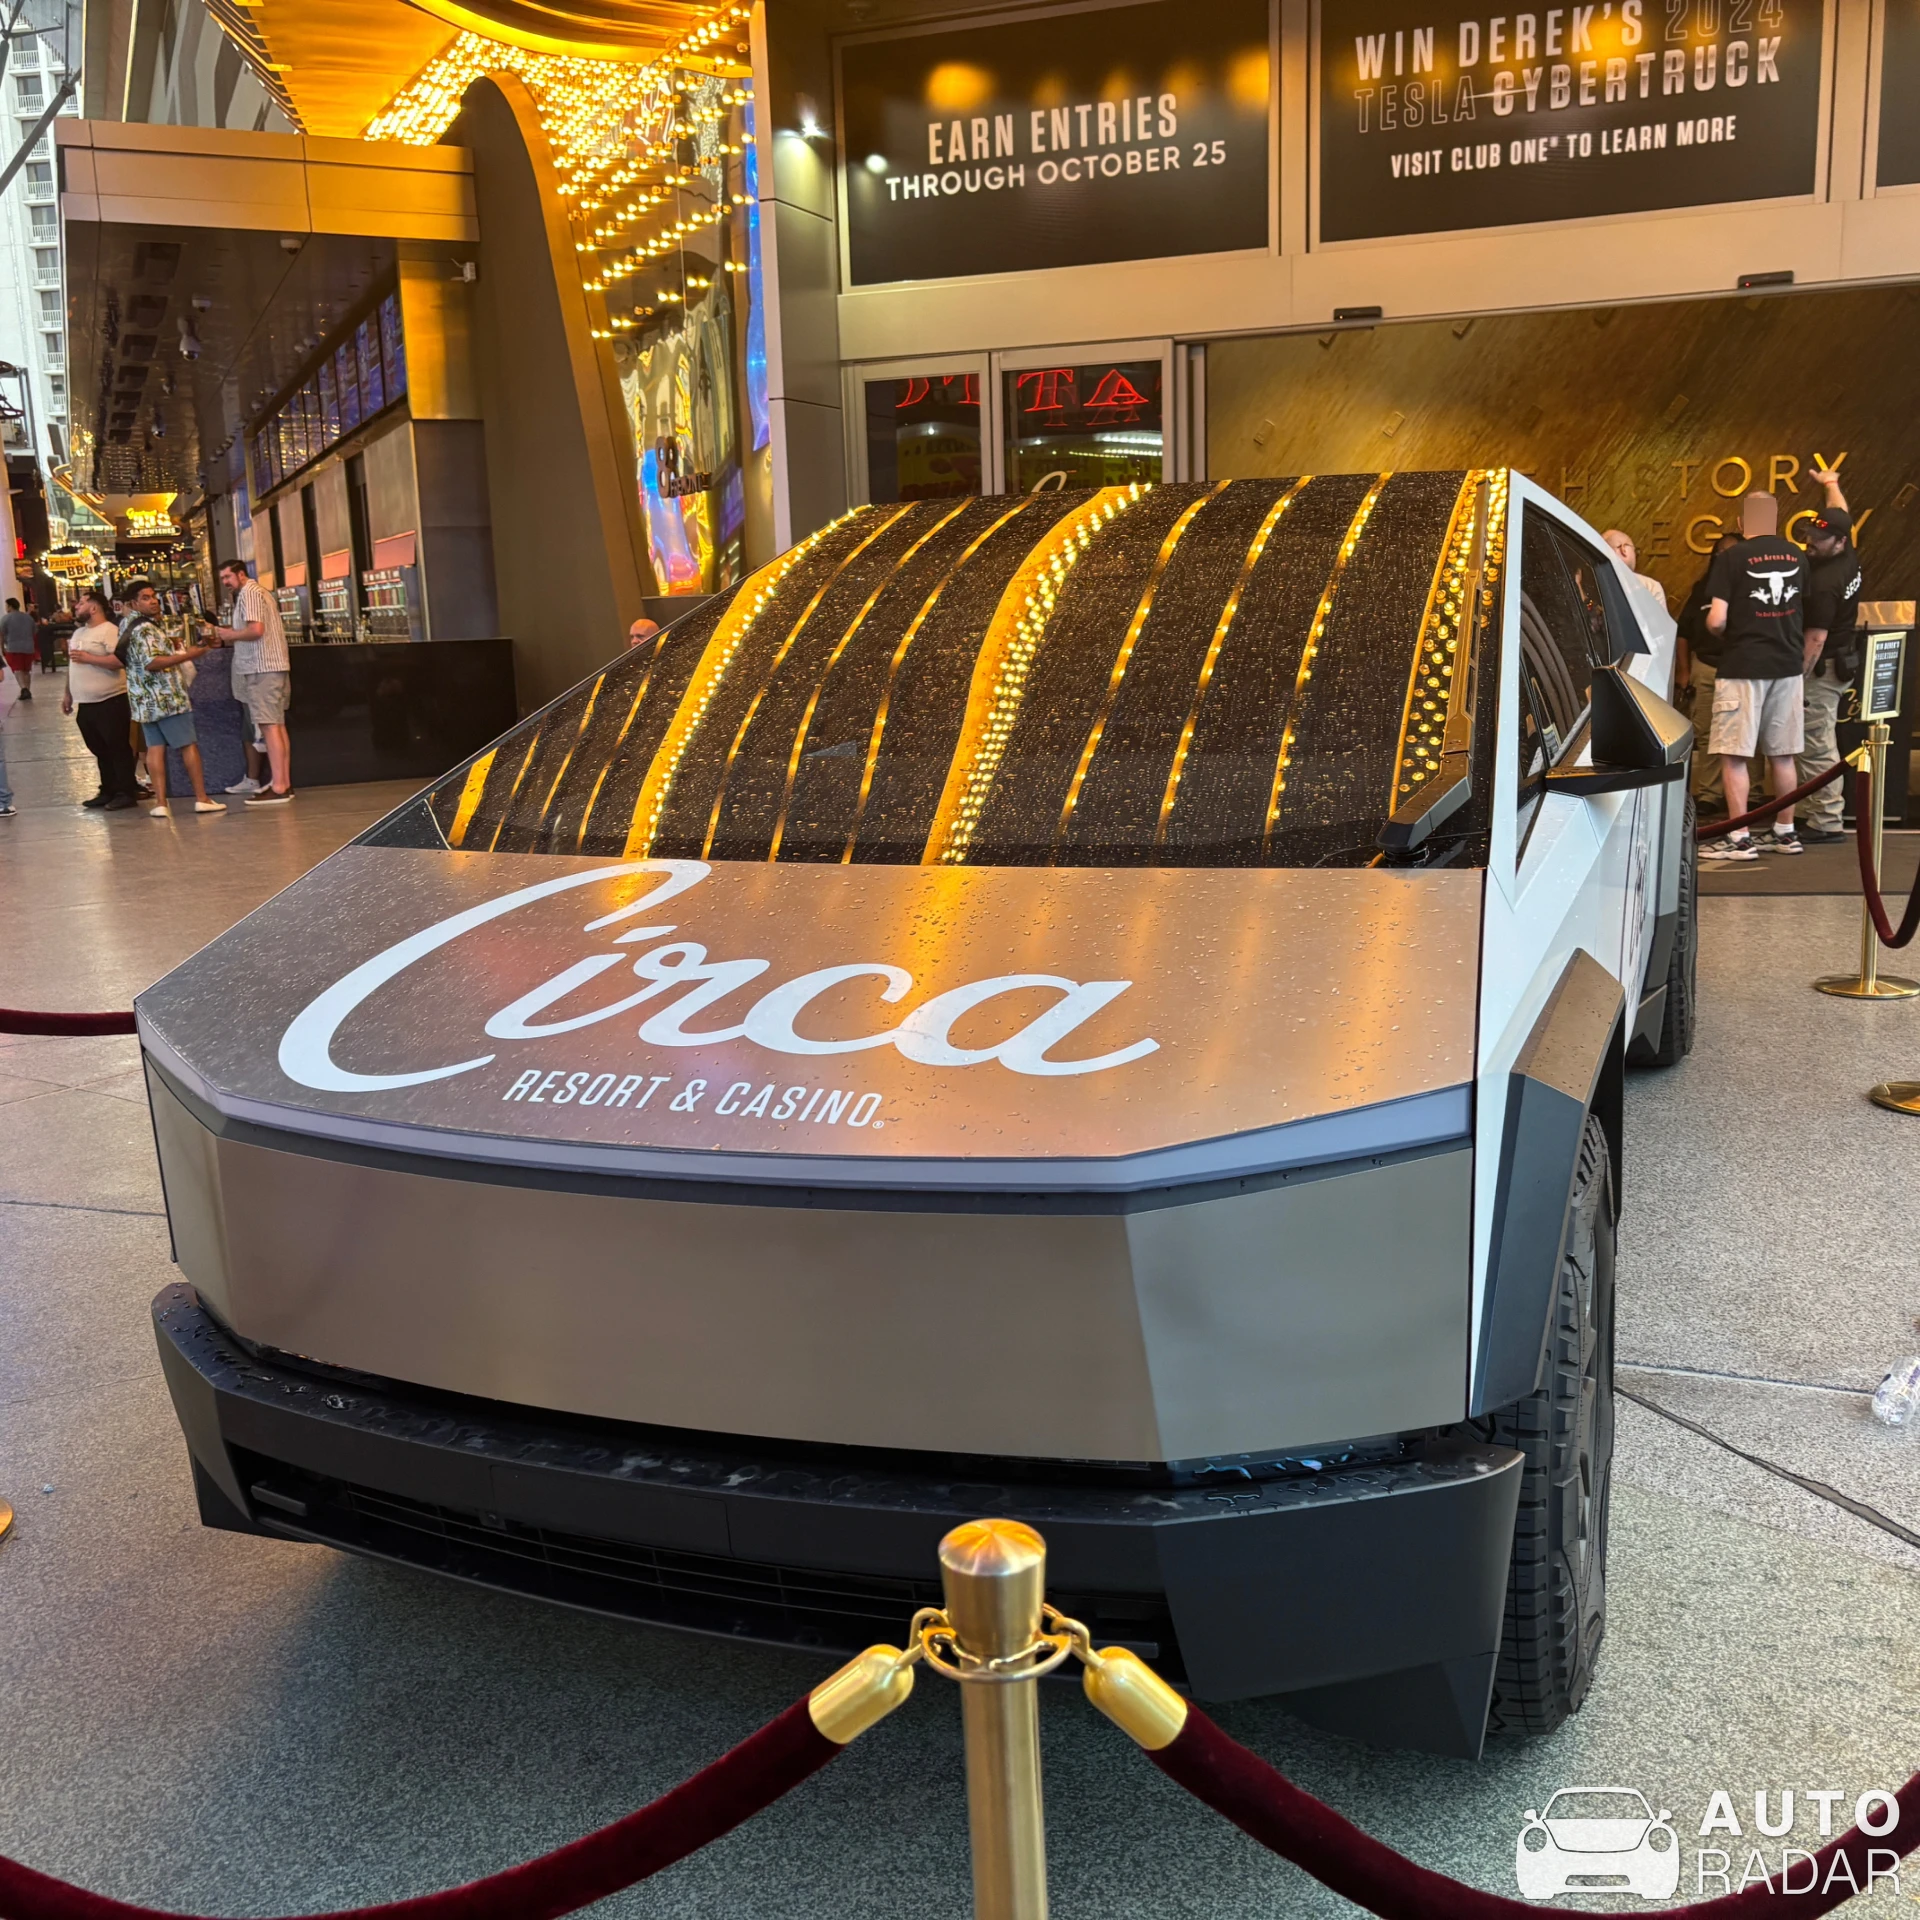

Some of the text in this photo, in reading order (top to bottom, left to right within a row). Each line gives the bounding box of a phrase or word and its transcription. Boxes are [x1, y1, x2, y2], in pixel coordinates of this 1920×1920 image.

[1355, 27, 1434, 81] WIN
[1458, 0, 1643, 68] DEREK'S
[1354, 36, 1783, 133] TESLA CYBERTRUCK
[928, 93, 1178, 165] EARN ENTRIES
[1391, 149, 1443, 179] VISIT
[1451, 142, 1501, 172] CLUB
[1567, 132, 1592, 158] TO
[1602, 124, 1667, 154] LEARN
[1677, 115, 1738, 146] MORE
[886, 140, 1227, 201] THROUGH OCTOBER 25
[278, 858, 1160, 1092] Circa
[502, 1069, 670, 1109] RESORT
[669, 1079, 706, 1113] &
